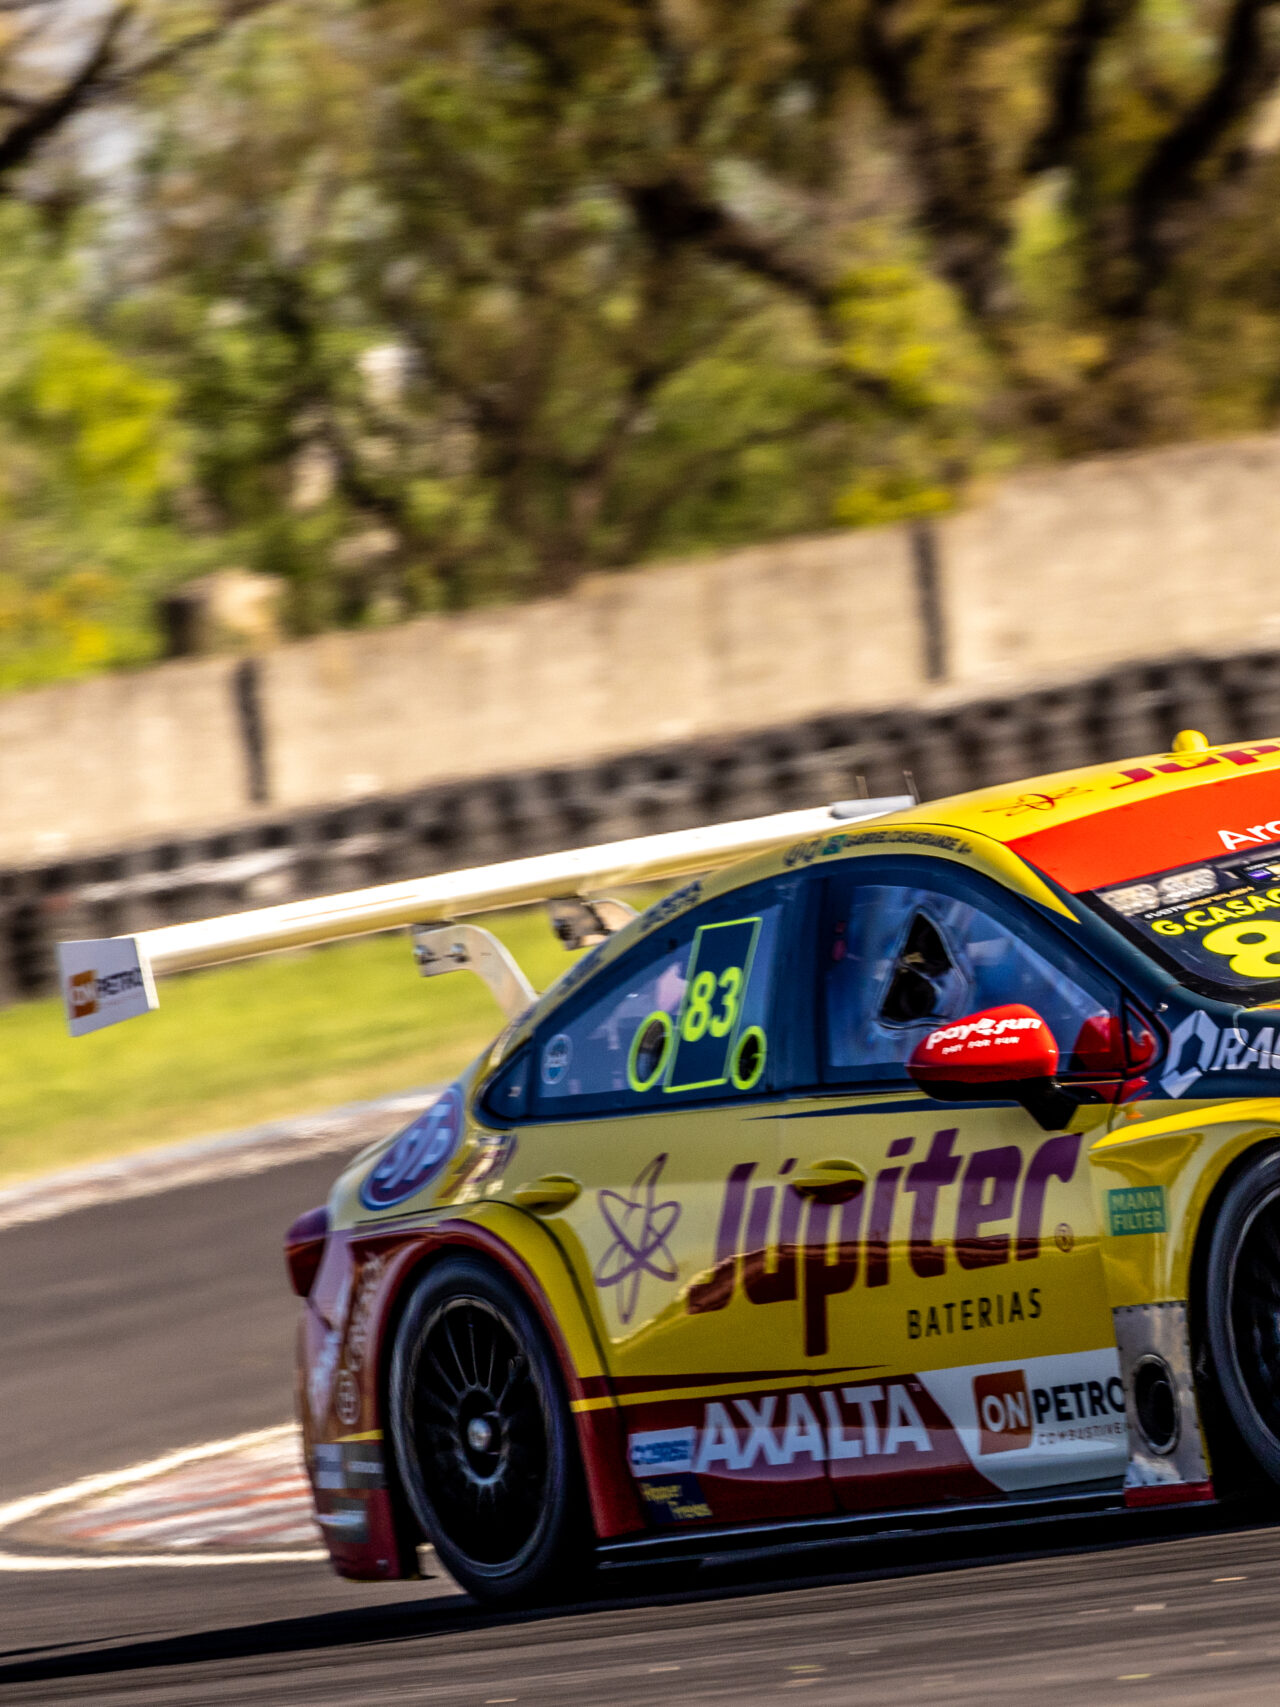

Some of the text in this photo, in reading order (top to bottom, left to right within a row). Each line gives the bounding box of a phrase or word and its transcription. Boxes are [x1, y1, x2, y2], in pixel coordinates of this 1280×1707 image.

[680, 966, 744, 1043] 83
[1111, 1191, 1161, 1211] MANN
[1113, 1211, 1163, 1231] FILTER
[907, 1287, 1043, 1341] BATERIAS
[694, 1383, 933, 1474] AXALTA
[981, 1376, 1126, 1433] ON PETRO
